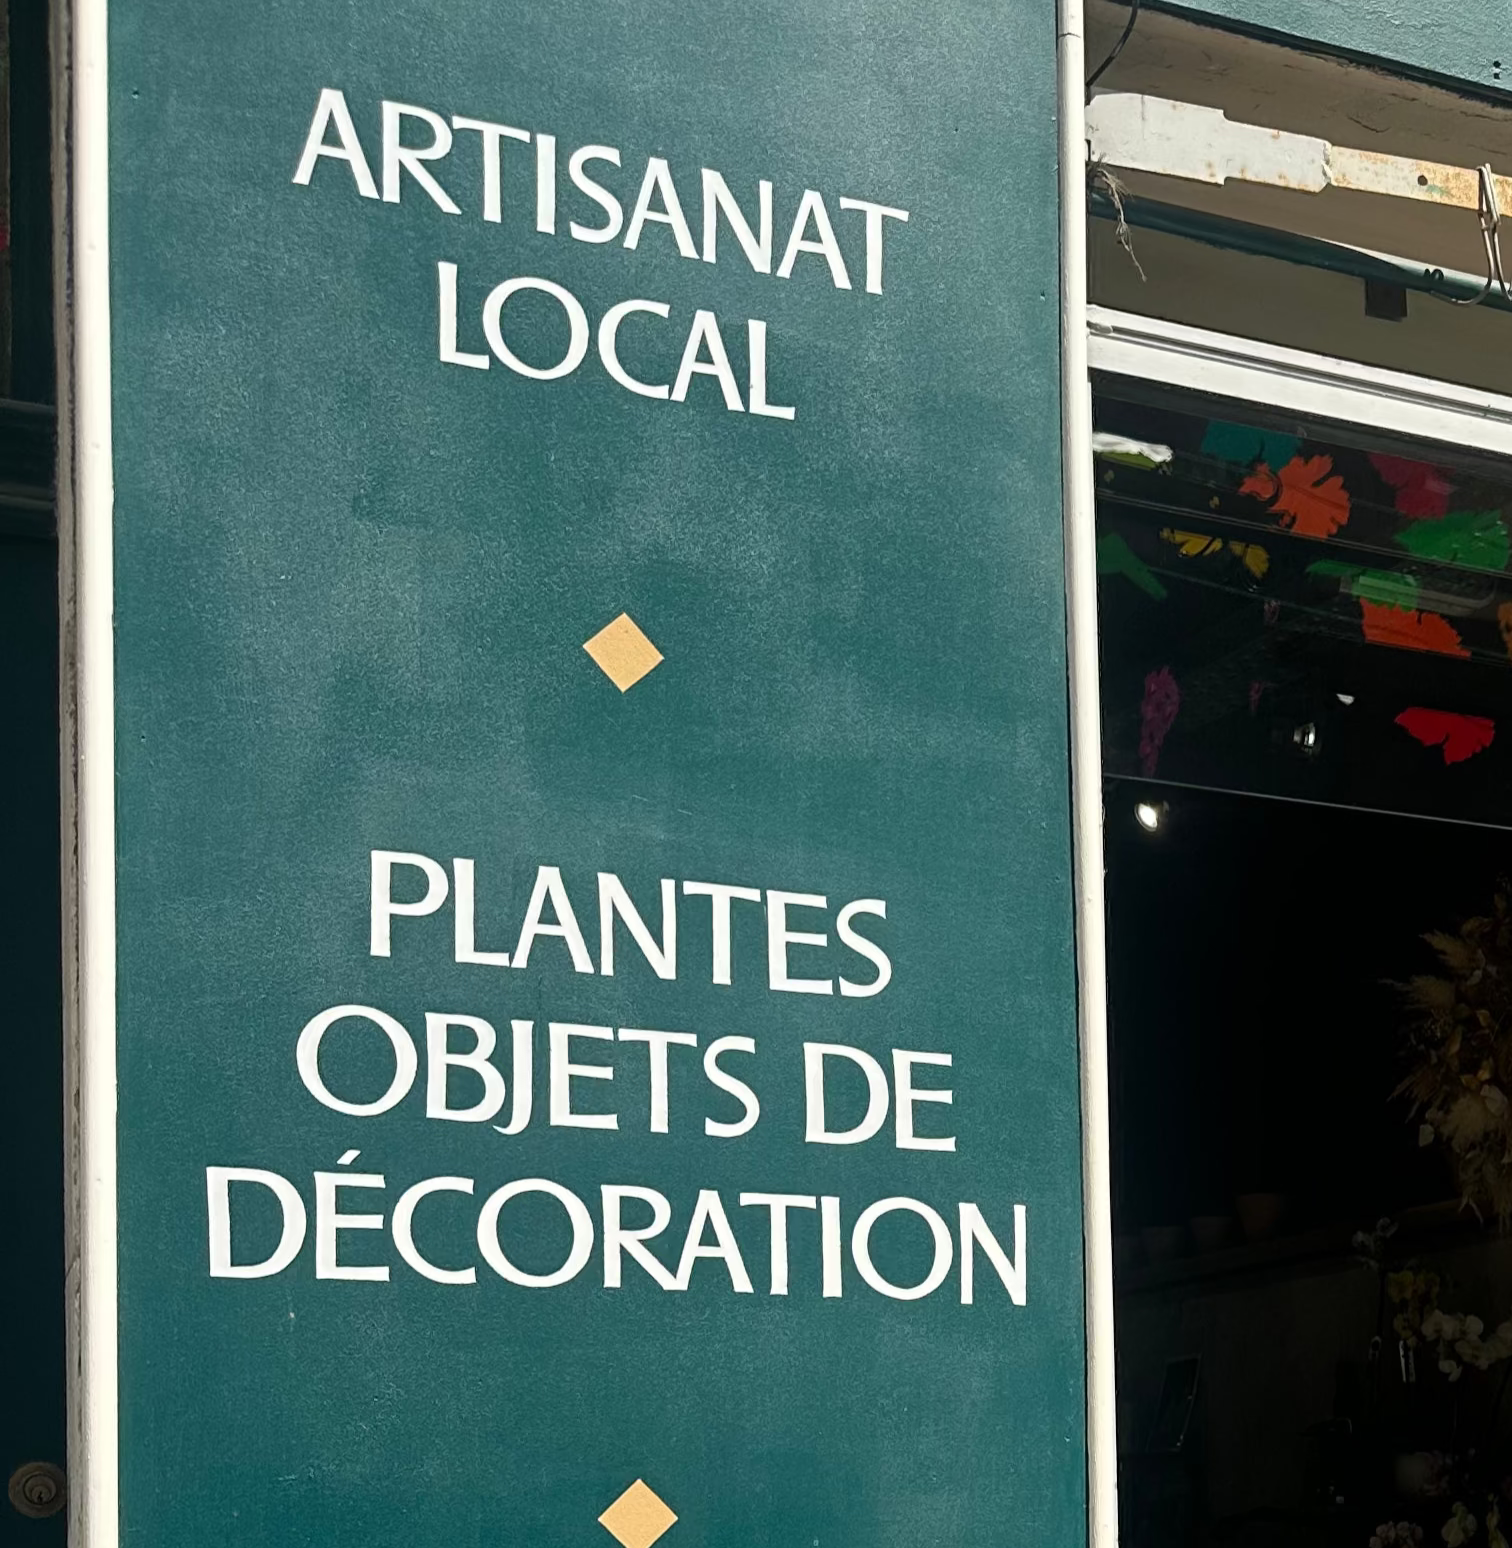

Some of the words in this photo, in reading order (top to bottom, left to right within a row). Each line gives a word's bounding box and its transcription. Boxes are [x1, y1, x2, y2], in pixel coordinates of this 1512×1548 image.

[294, 88, 910, 295] ARTISANAT
[440, 262, 800, 420] LOCAL
[370, 849, 892, 996] PLANTES
[297, 1006, 760, 1136] OBJETS
[804, 1044, 954, 1150] DE
[206, 1149, 1026, 1306] DÉCORATION
